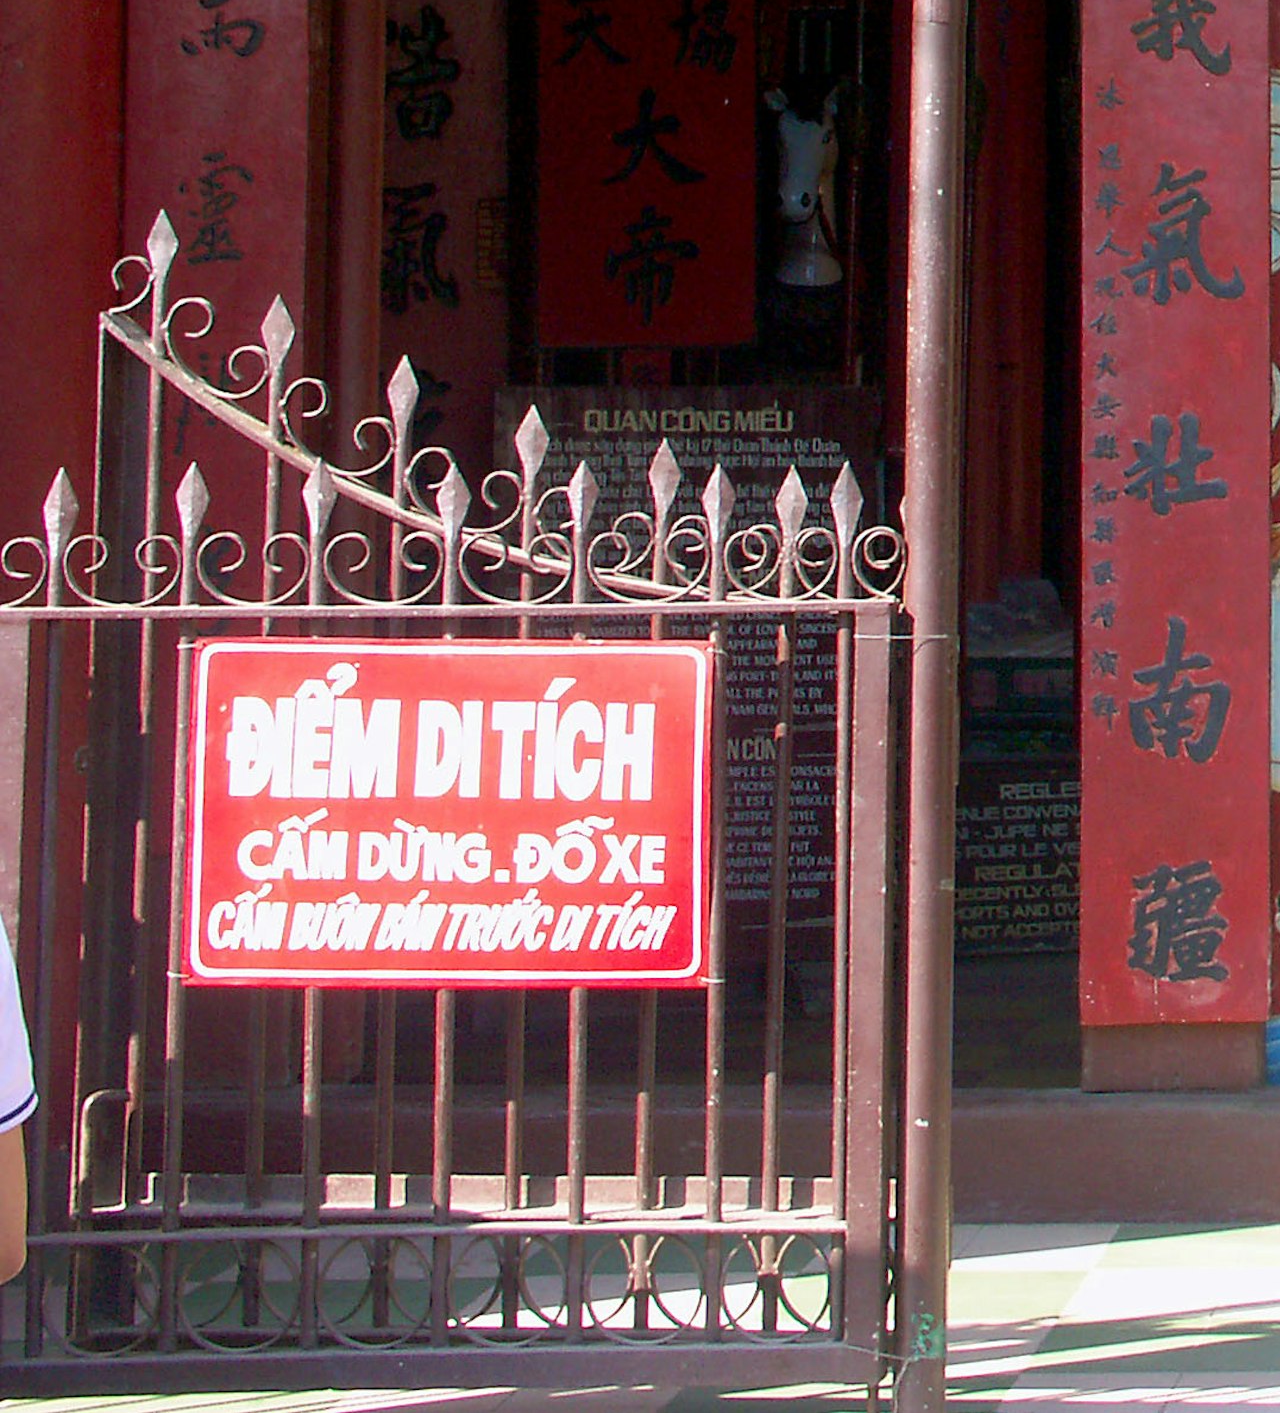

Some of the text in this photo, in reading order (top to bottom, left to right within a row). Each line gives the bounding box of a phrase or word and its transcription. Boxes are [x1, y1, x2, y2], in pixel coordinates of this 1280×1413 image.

[583, 410, 656, 432] QUAN
[661, 405, 730, 432] CÔNG
[226, 662, 656, 801] ĐIỂM DI TÍCH
[236, 807, 348, 881] CẤM
[599, 834, 667, 884] XE
[965, 843, 1017, 859] POUR
[1020, 842, 1049, 857] LE
[207, 883, 677, 952] CẤM BUÔN BÁN TRƯỚC DI TÍCH
[1013, 902, 1050, 918] AND
